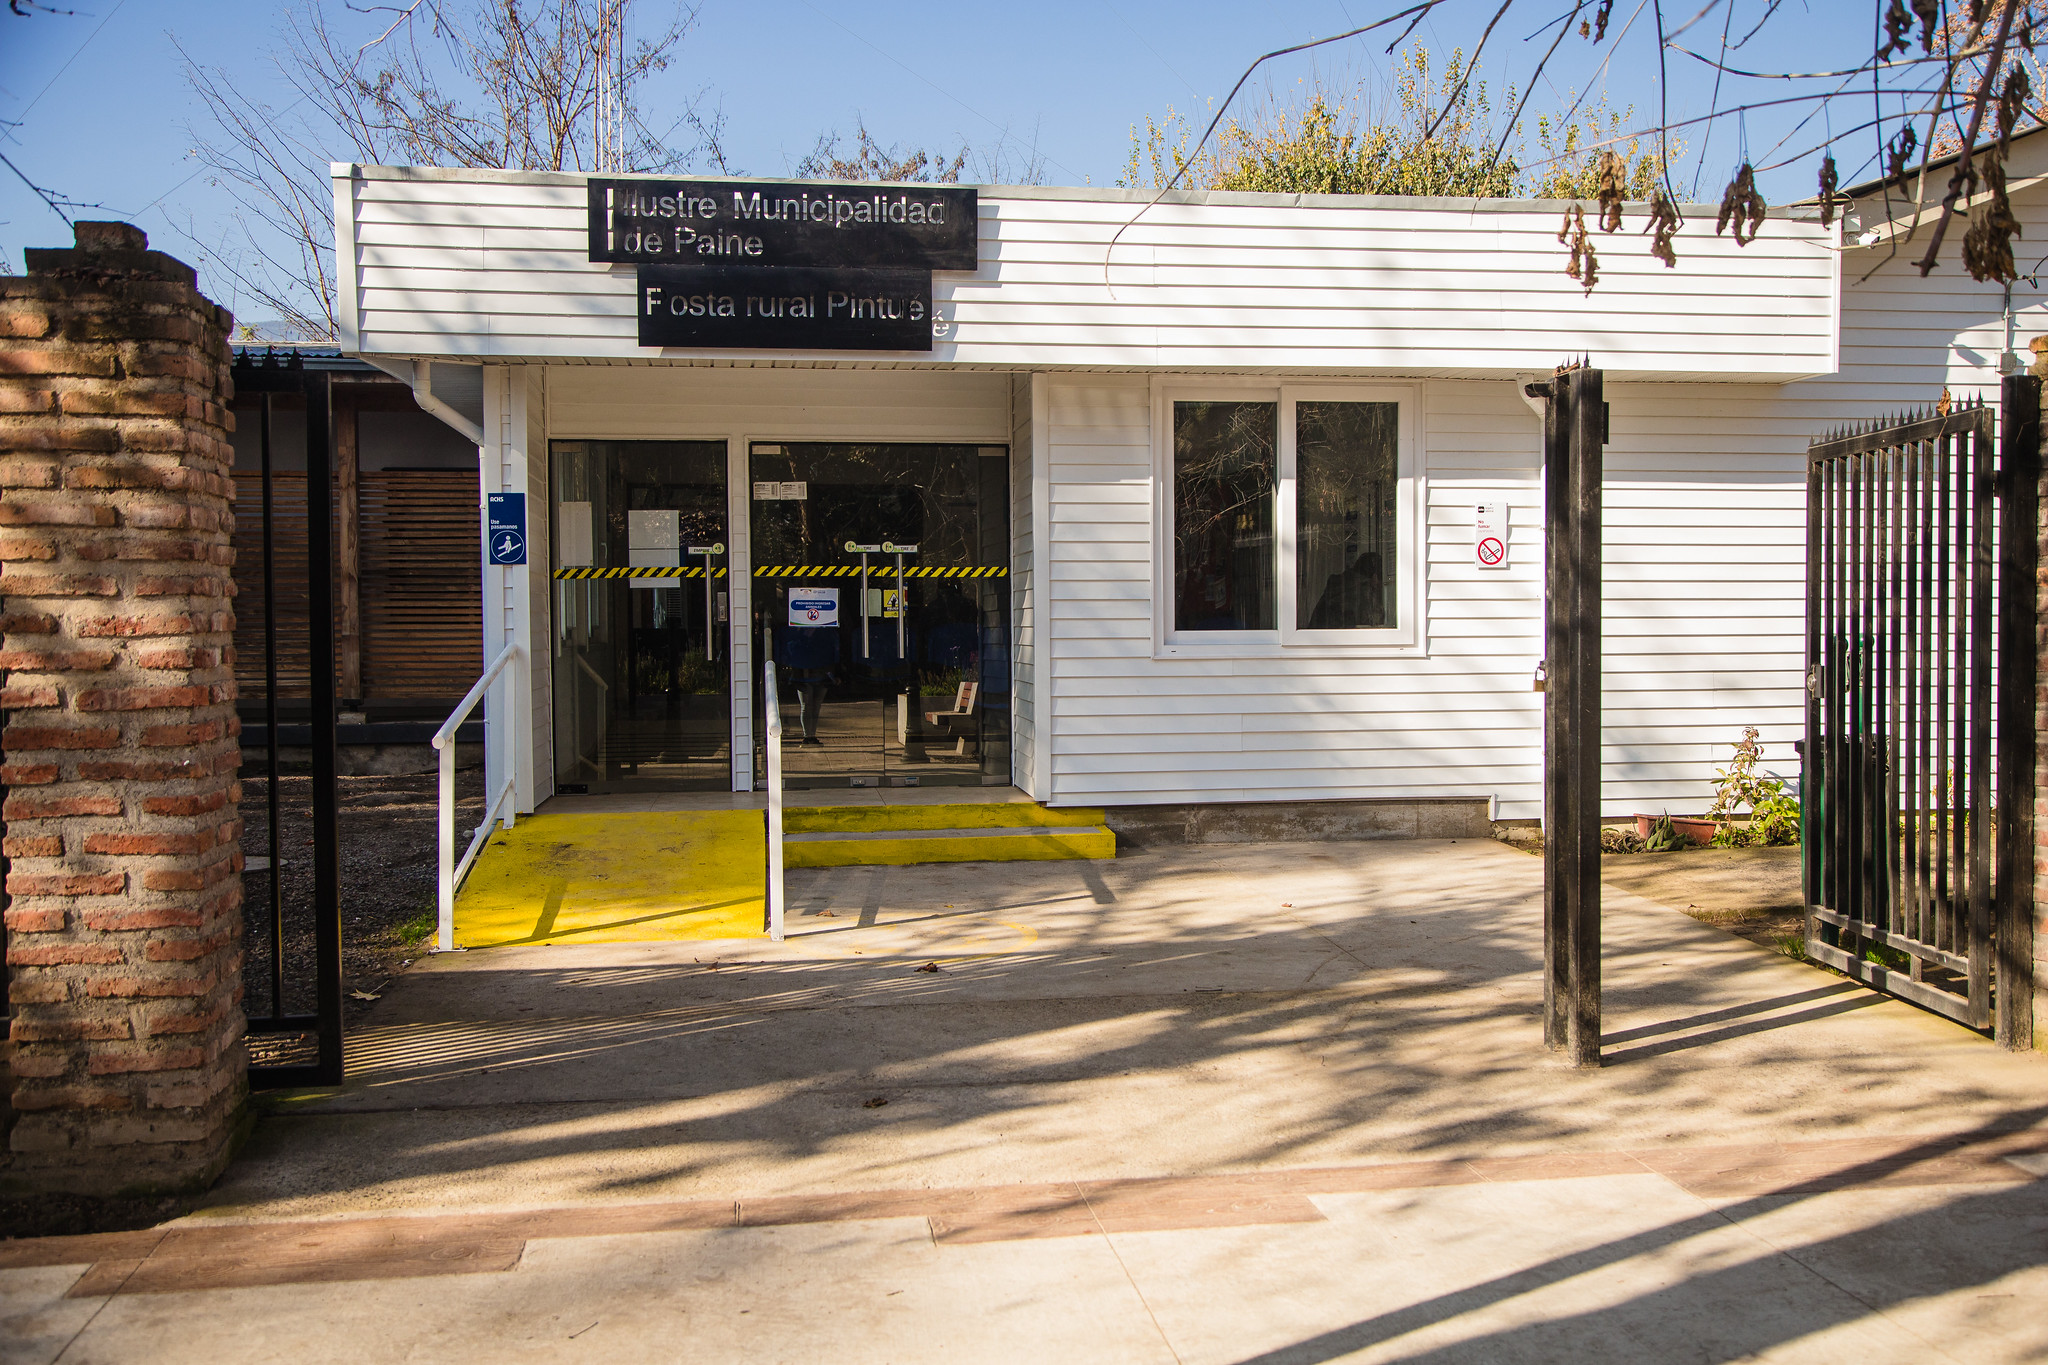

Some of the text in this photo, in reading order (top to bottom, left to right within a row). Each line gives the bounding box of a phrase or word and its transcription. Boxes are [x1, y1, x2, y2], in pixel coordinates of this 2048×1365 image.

[733, 191, 944, 229] Municipalidad
[624, 226, 764, 257] de Paine
[747, 290, 815, 319] rural
[827, 290, 925, 321] Pintué
